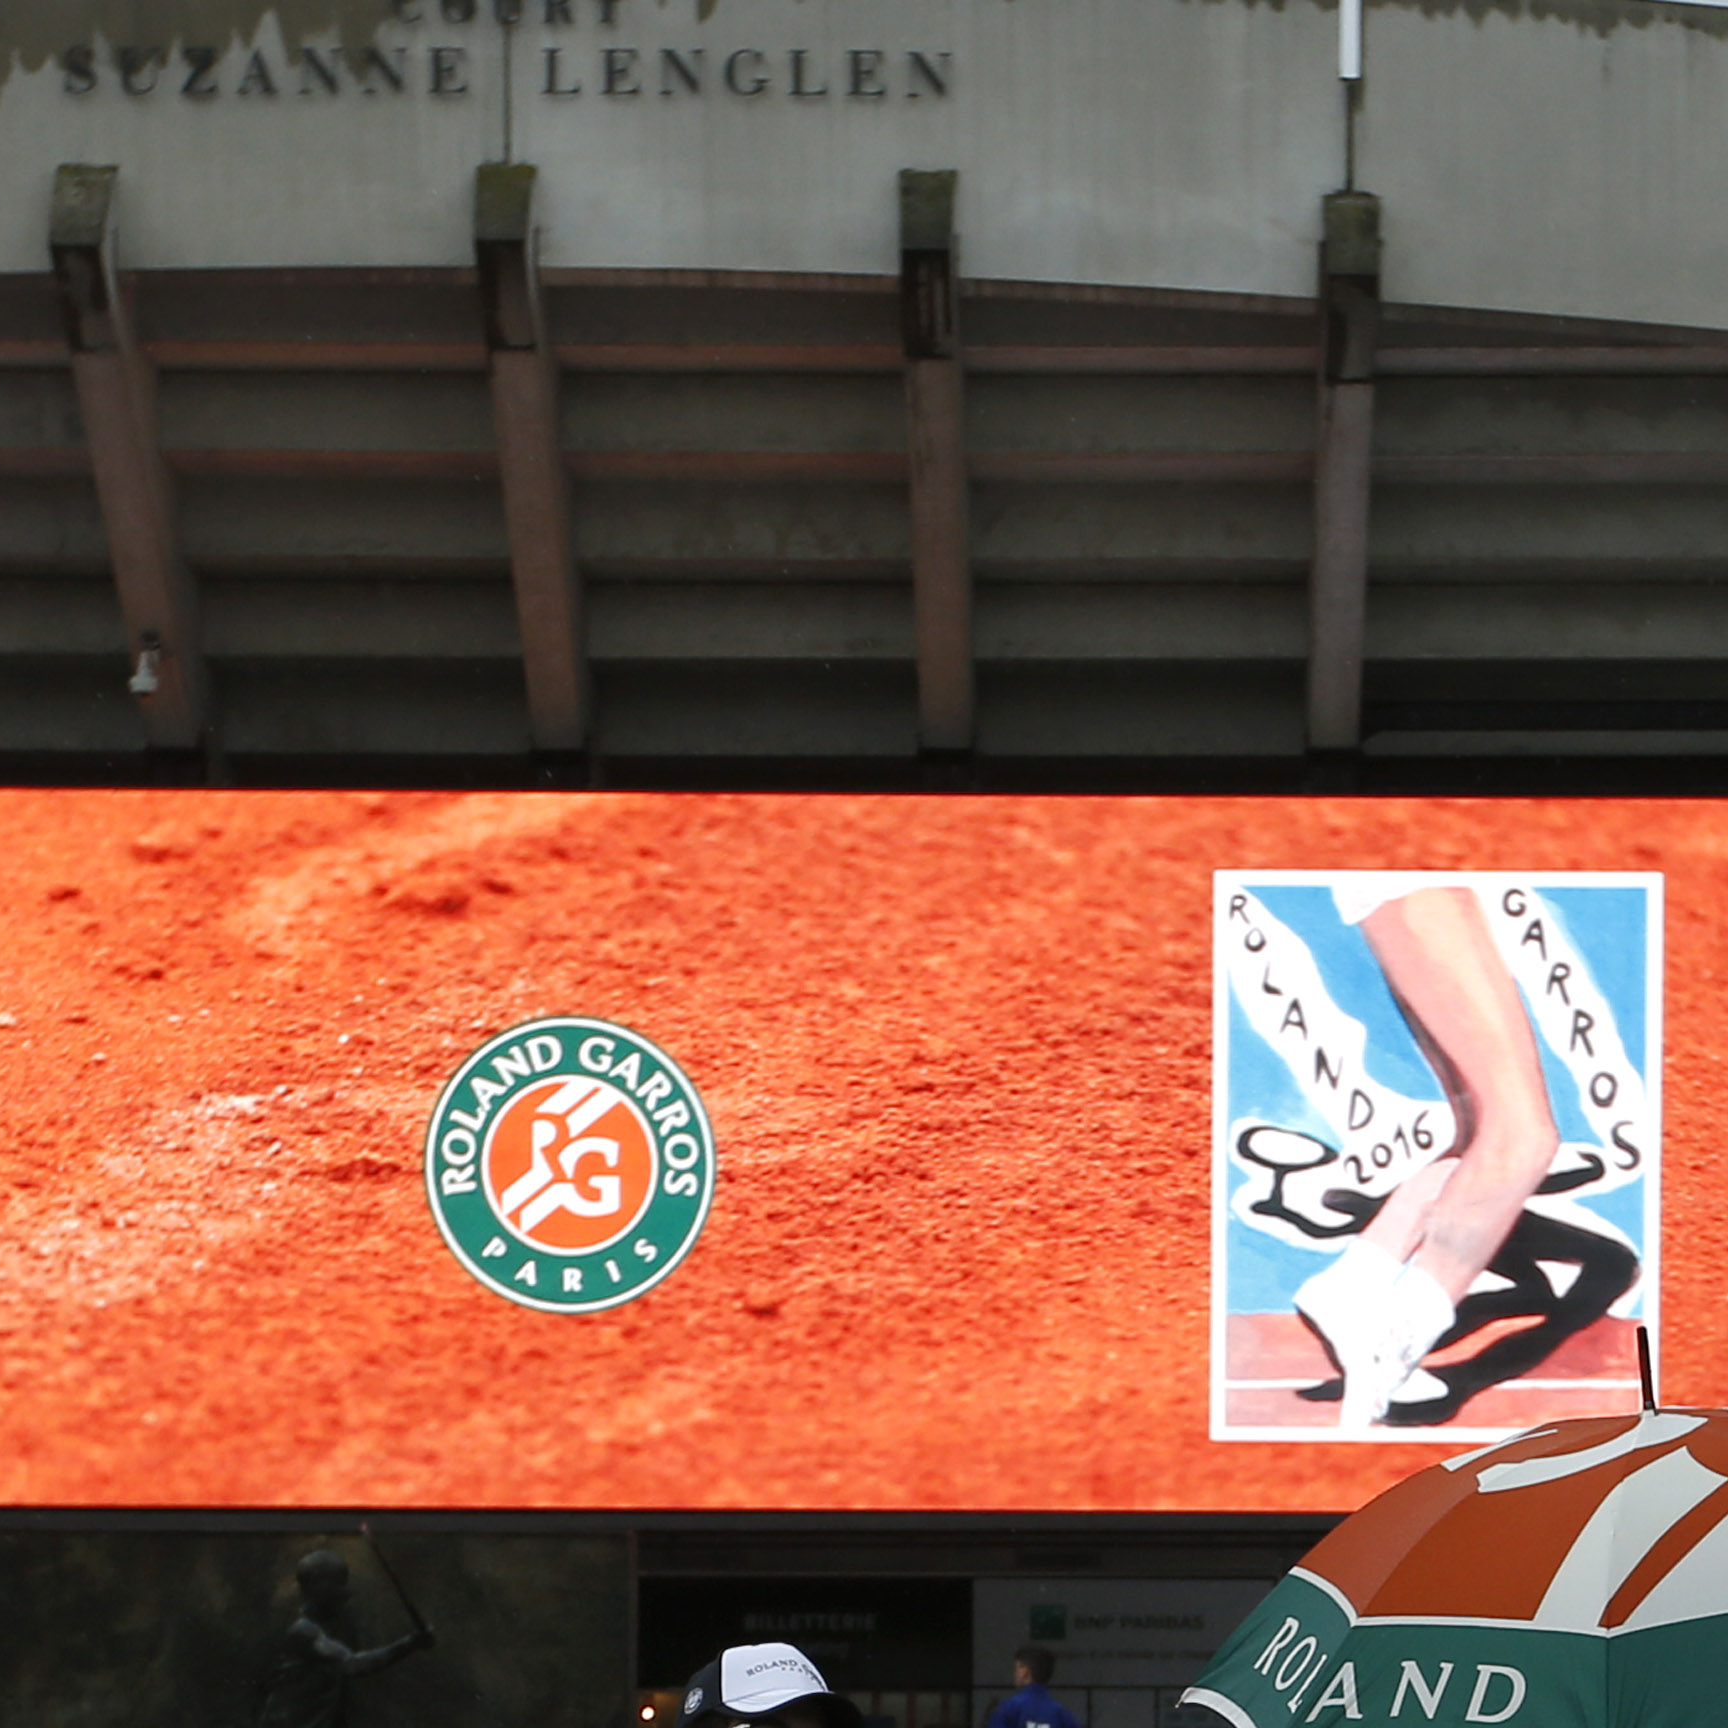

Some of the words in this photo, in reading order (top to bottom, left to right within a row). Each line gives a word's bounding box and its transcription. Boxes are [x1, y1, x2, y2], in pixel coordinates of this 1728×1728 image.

[62, 47, 470, 98] SUZANNE
[541, 48, 954, 98] LENGLEN
[1229, 894, 1374, 1131] ROLAND
[1502, 888, 1641, 1170] GARROS
[440, 1034, 563, 1197] ROLAND
[578, 1035, 700, 1197] GARROS
[1342, 1109, 1434, 1184] 2016
[481, 1236, 658, 1293] PARIS
[1253, 1615, 1528, 1724] ROLAND
